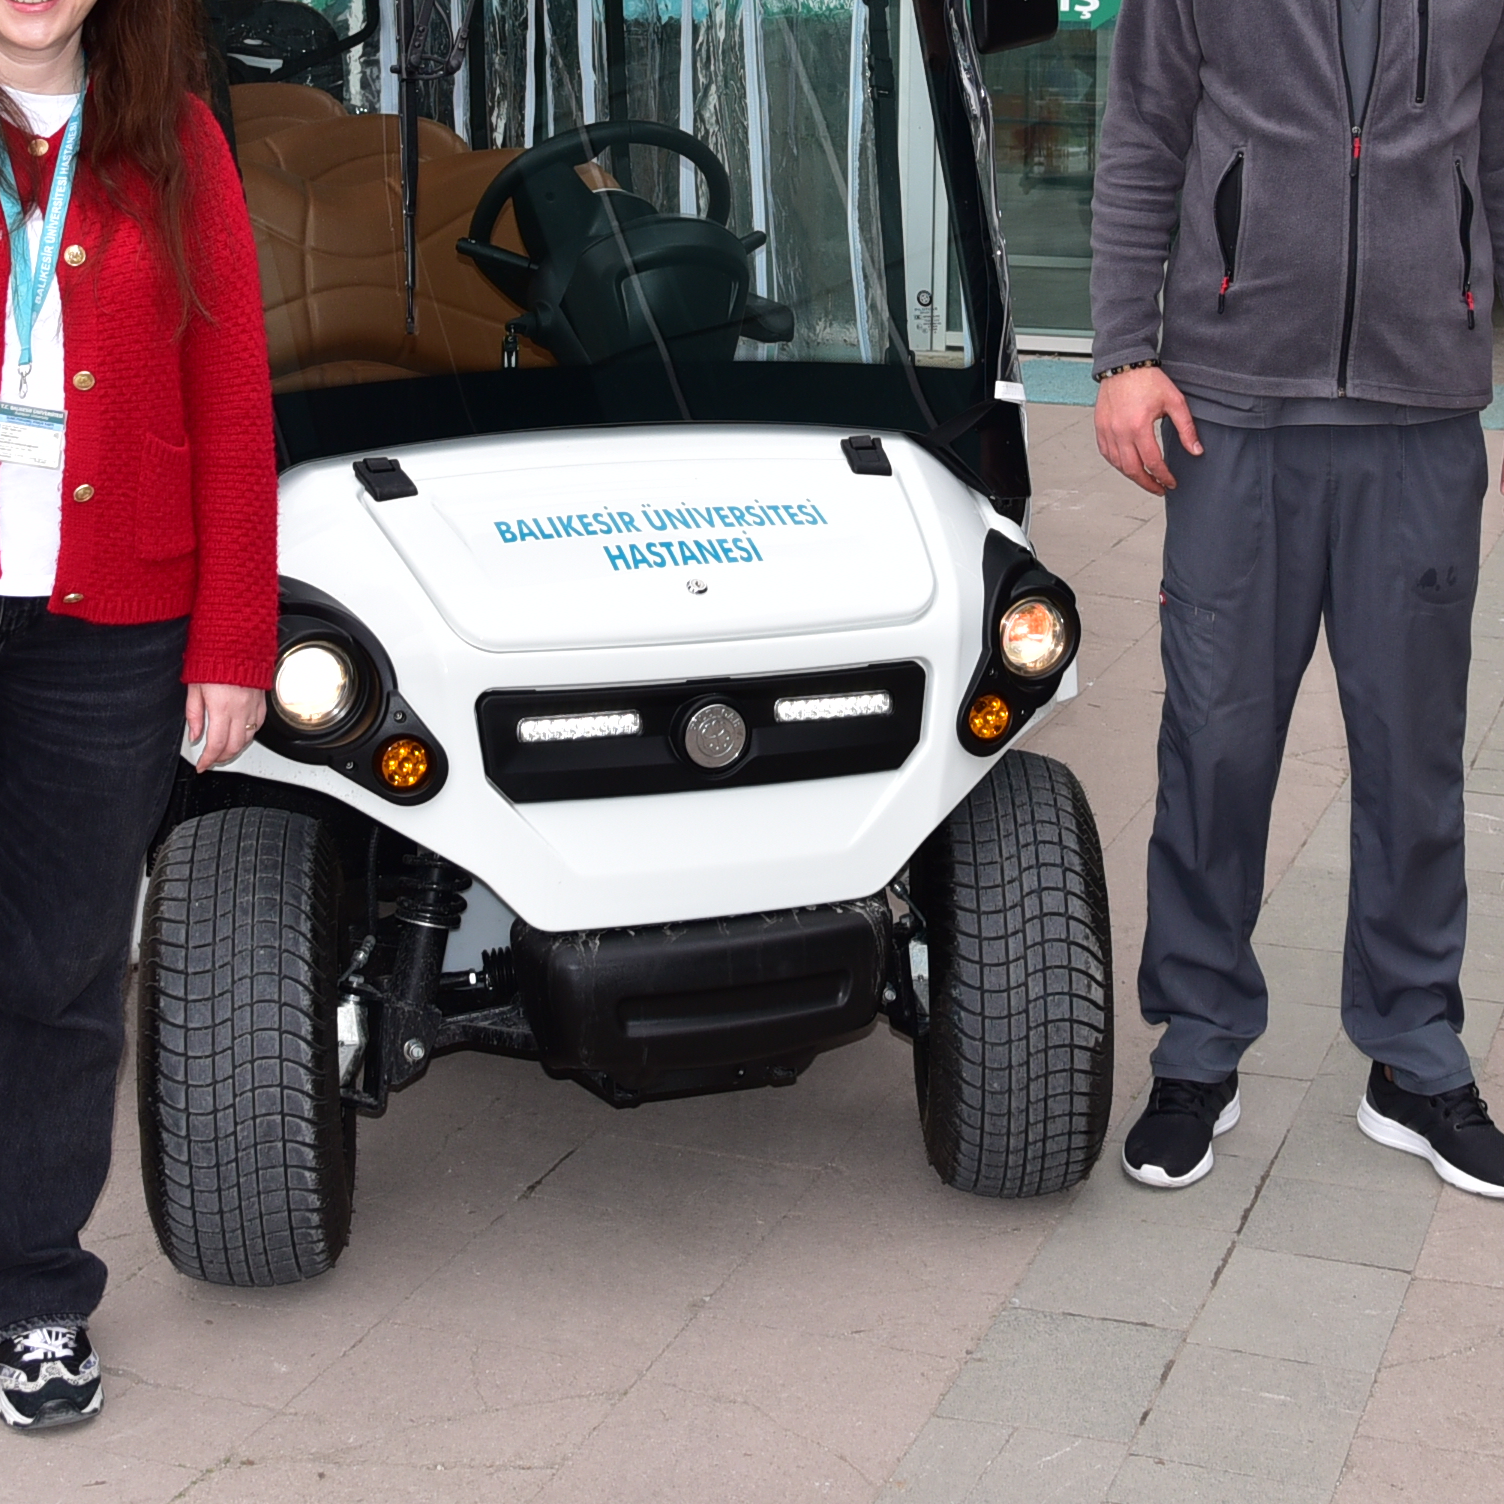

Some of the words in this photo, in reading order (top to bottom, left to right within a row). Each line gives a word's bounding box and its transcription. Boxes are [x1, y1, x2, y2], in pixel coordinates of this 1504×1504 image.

[494, 505, 643, 544] BALIKESİR
[640, 498, 829, 533] ÜNİVERSİTESİ
[603, 530, 764, 571] HASTANESİ
